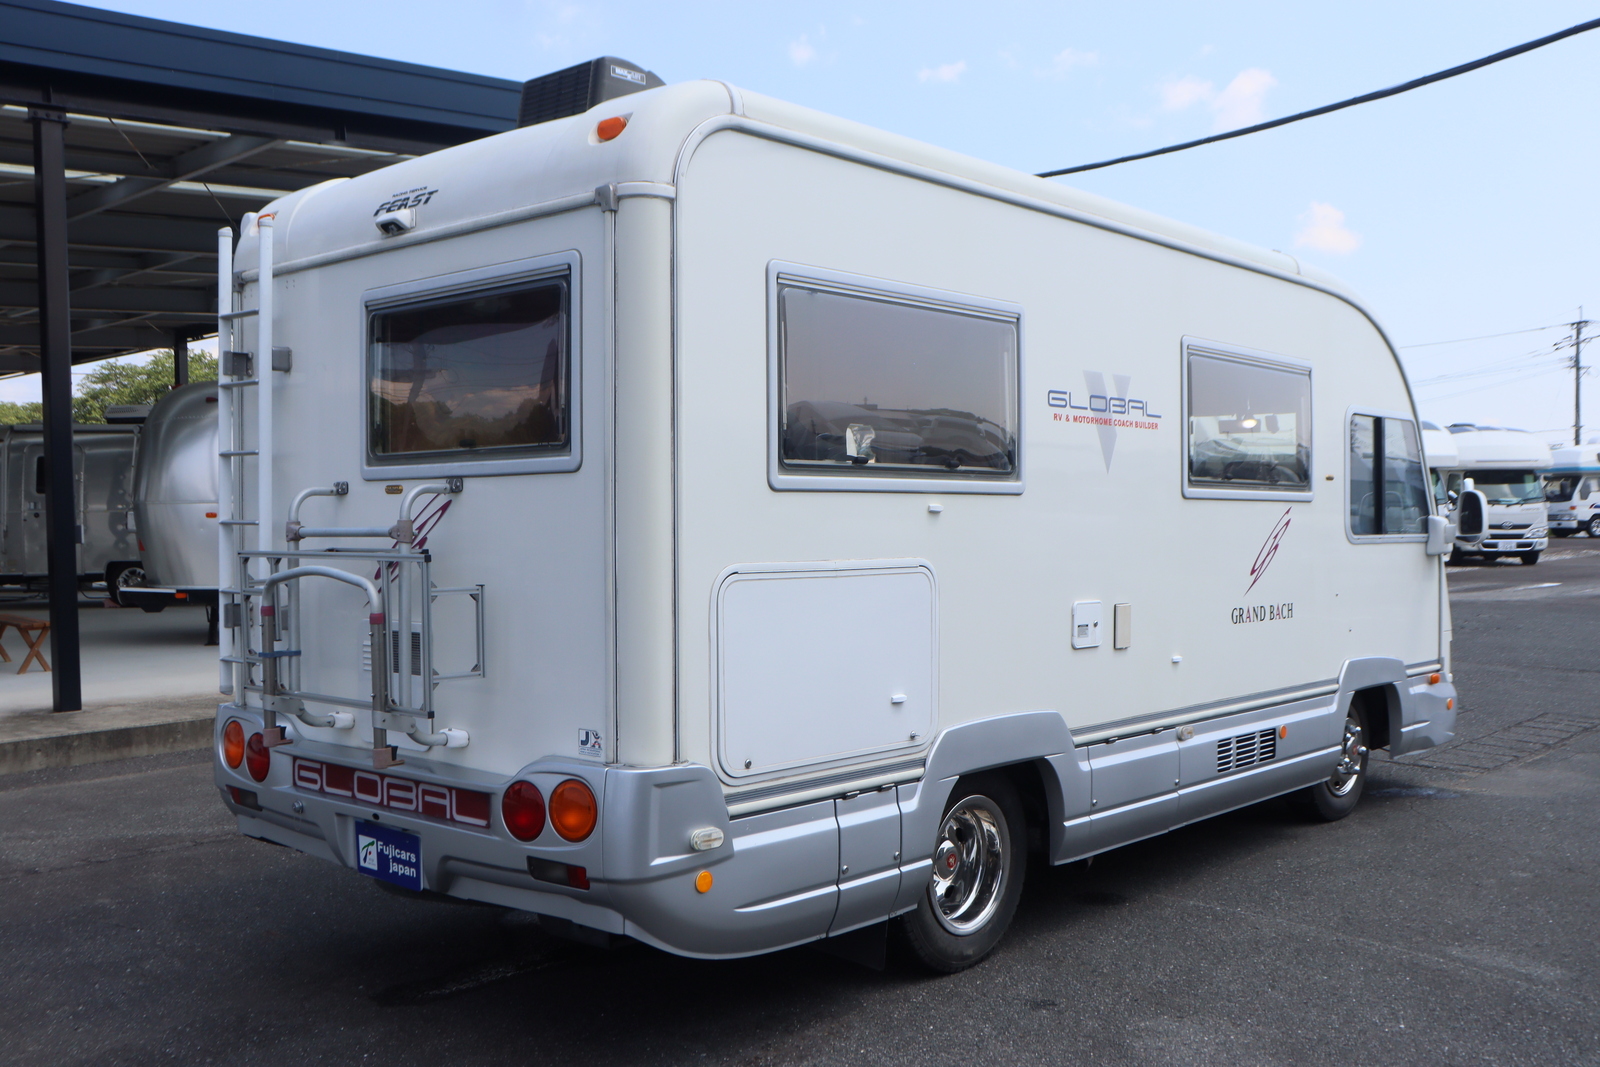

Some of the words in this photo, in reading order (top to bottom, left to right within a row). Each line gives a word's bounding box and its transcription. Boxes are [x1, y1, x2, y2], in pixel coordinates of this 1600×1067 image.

[373, 189, 439, 217] FEAST
[1047, 389, 1162, 419] GLOBAL
[1053, 413, 1062, 421] RV
[1065, 414, 1070, 422] &
[1073, 415, 1113, 426] MOTORHOME
[1113, 419, 1134, 428] COACH
[1135, 421, 1159, 430] BUILDER
[1231, 605, 1266, 625] GRAND
[1269, 602, 1293, 621] BACH
[294, 758, 488, 827] GLOBAL
[377, 841, 416, 863] Fujicars
[389, 859, 416, 878] japan
